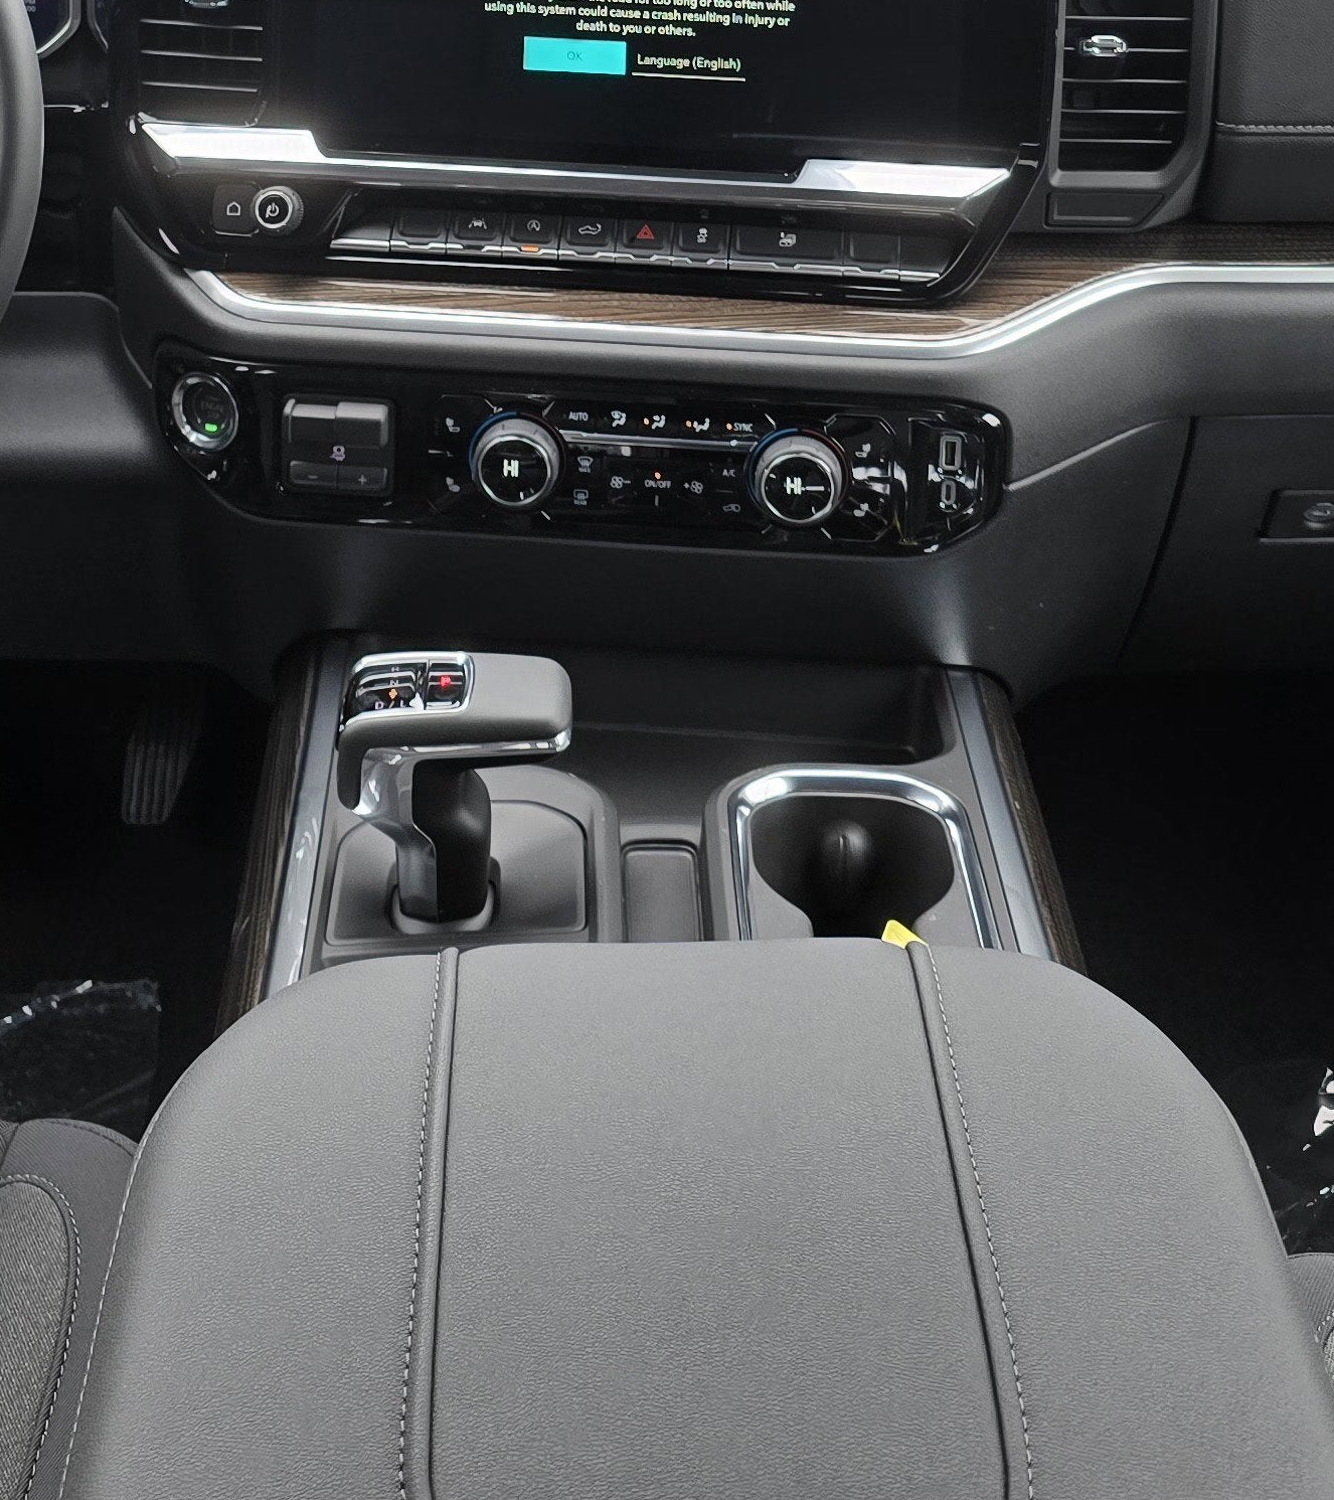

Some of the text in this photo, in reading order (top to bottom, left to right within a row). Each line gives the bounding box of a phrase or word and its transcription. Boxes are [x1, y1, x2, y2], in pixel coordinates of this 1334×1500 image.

[765, 0, 796, 12] while
[484, 1, 791, 28] using this system could cause a crash resulting in injury or
[575, 19, 696, 36] death to you or others.
[566, 51, 584, 61] OK
[637, 53, 742, 72] Language (English)
[568, 411, 589, 422] AUTO
[733, 422, 753, 433] SYNC
[502, 458, 519, 478] HI
[722, 469, 736, 477] A/C
[644, 478, 672, 489] ON/OFF
[786, 476, 803, 495] HI
